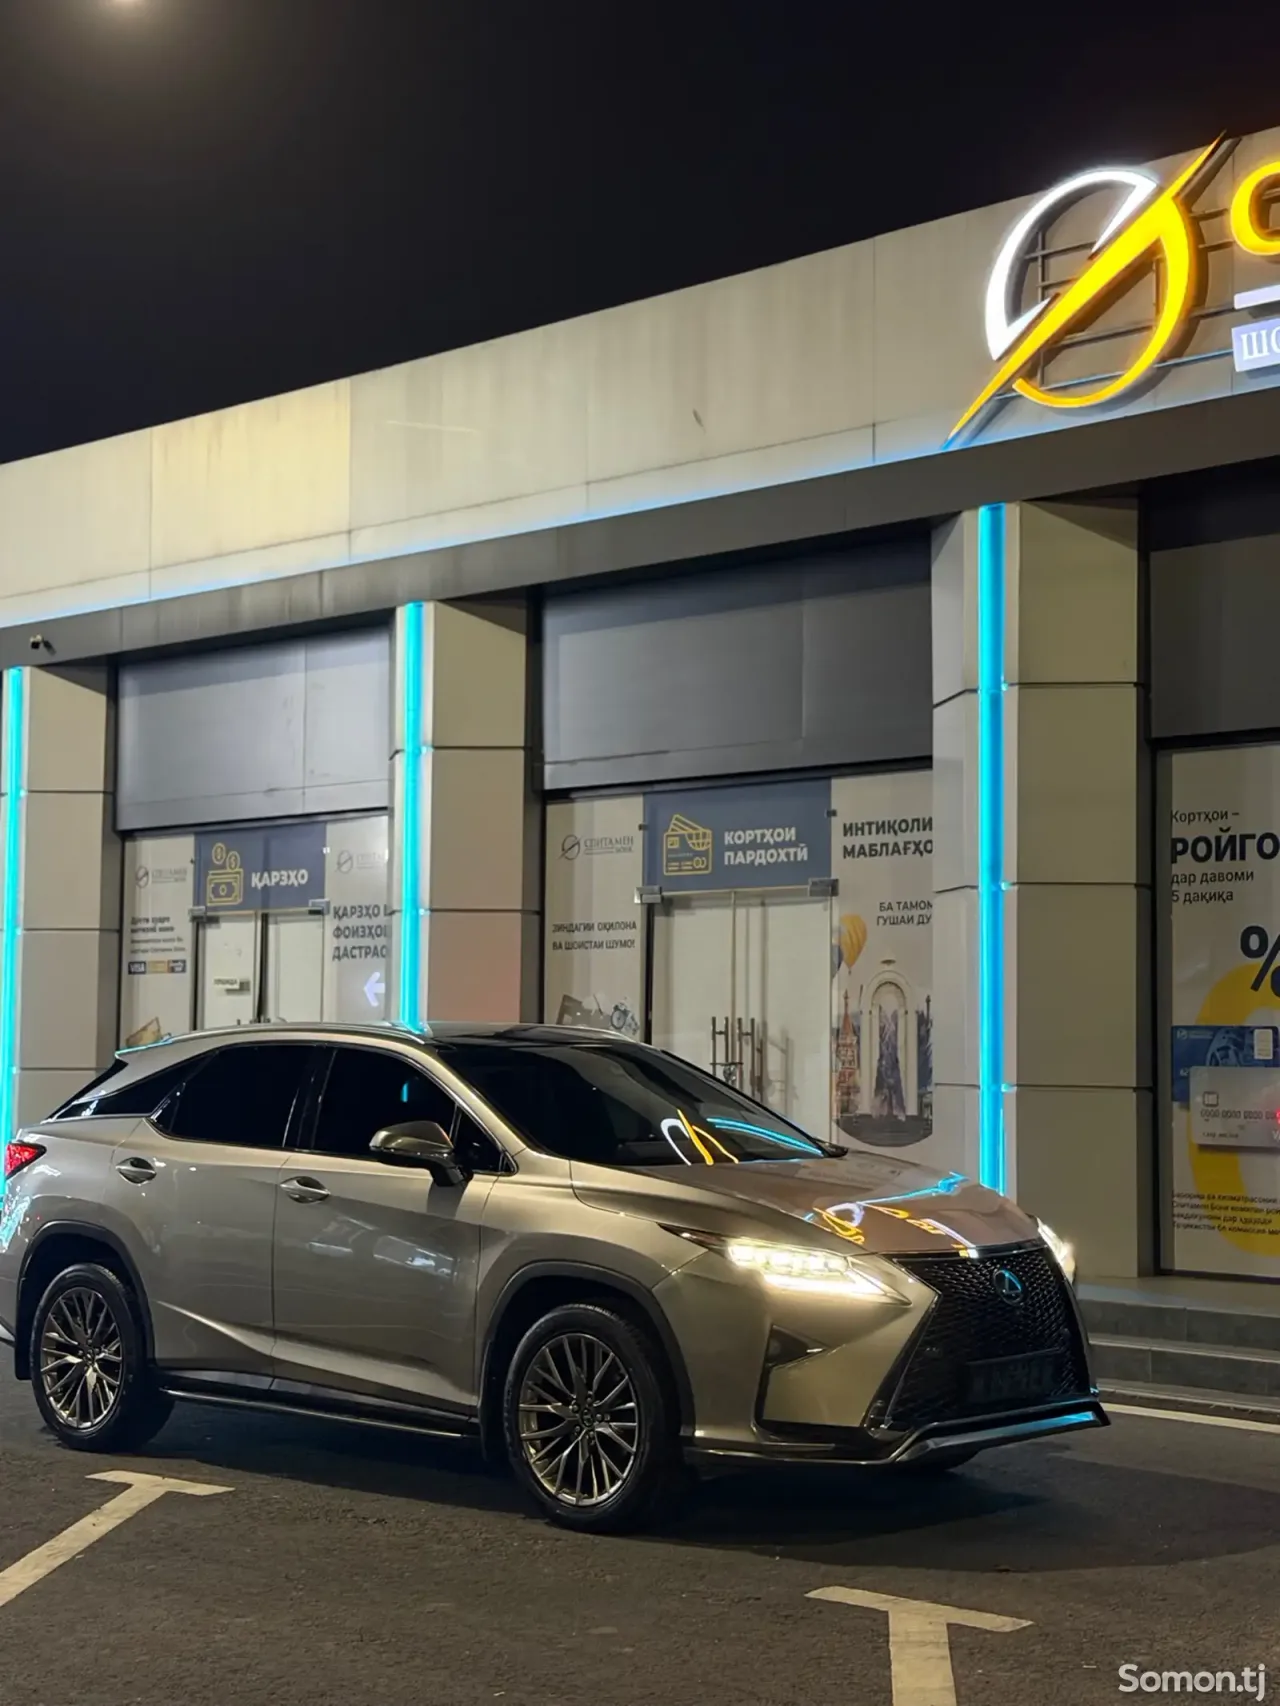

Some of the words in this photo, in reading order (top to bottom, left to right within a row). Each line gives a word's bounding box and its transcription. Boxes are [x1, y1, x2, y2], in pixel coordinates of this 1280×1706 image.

[843, 817, 932, 837] ИНТИҚОЛИ
[724, 827, 796, 845] КОРТҲОИ
[843, 840, 932, 859] МАБЛАҒҲО
[1171, 826, 1280, 864] РОЙГО
[251, 869, 308, 890] ҚАРЗҲО
[1171, 873, 1196, 886] дар
[1200, 871, 1254, 885] давоми
[1183, 890, 1234, 905] дақиқа
[333, 904, 381, 921] ҚАРЗҲО
[879, 902, 893, 912] БА
[552, 941, 563, 950] ВА
